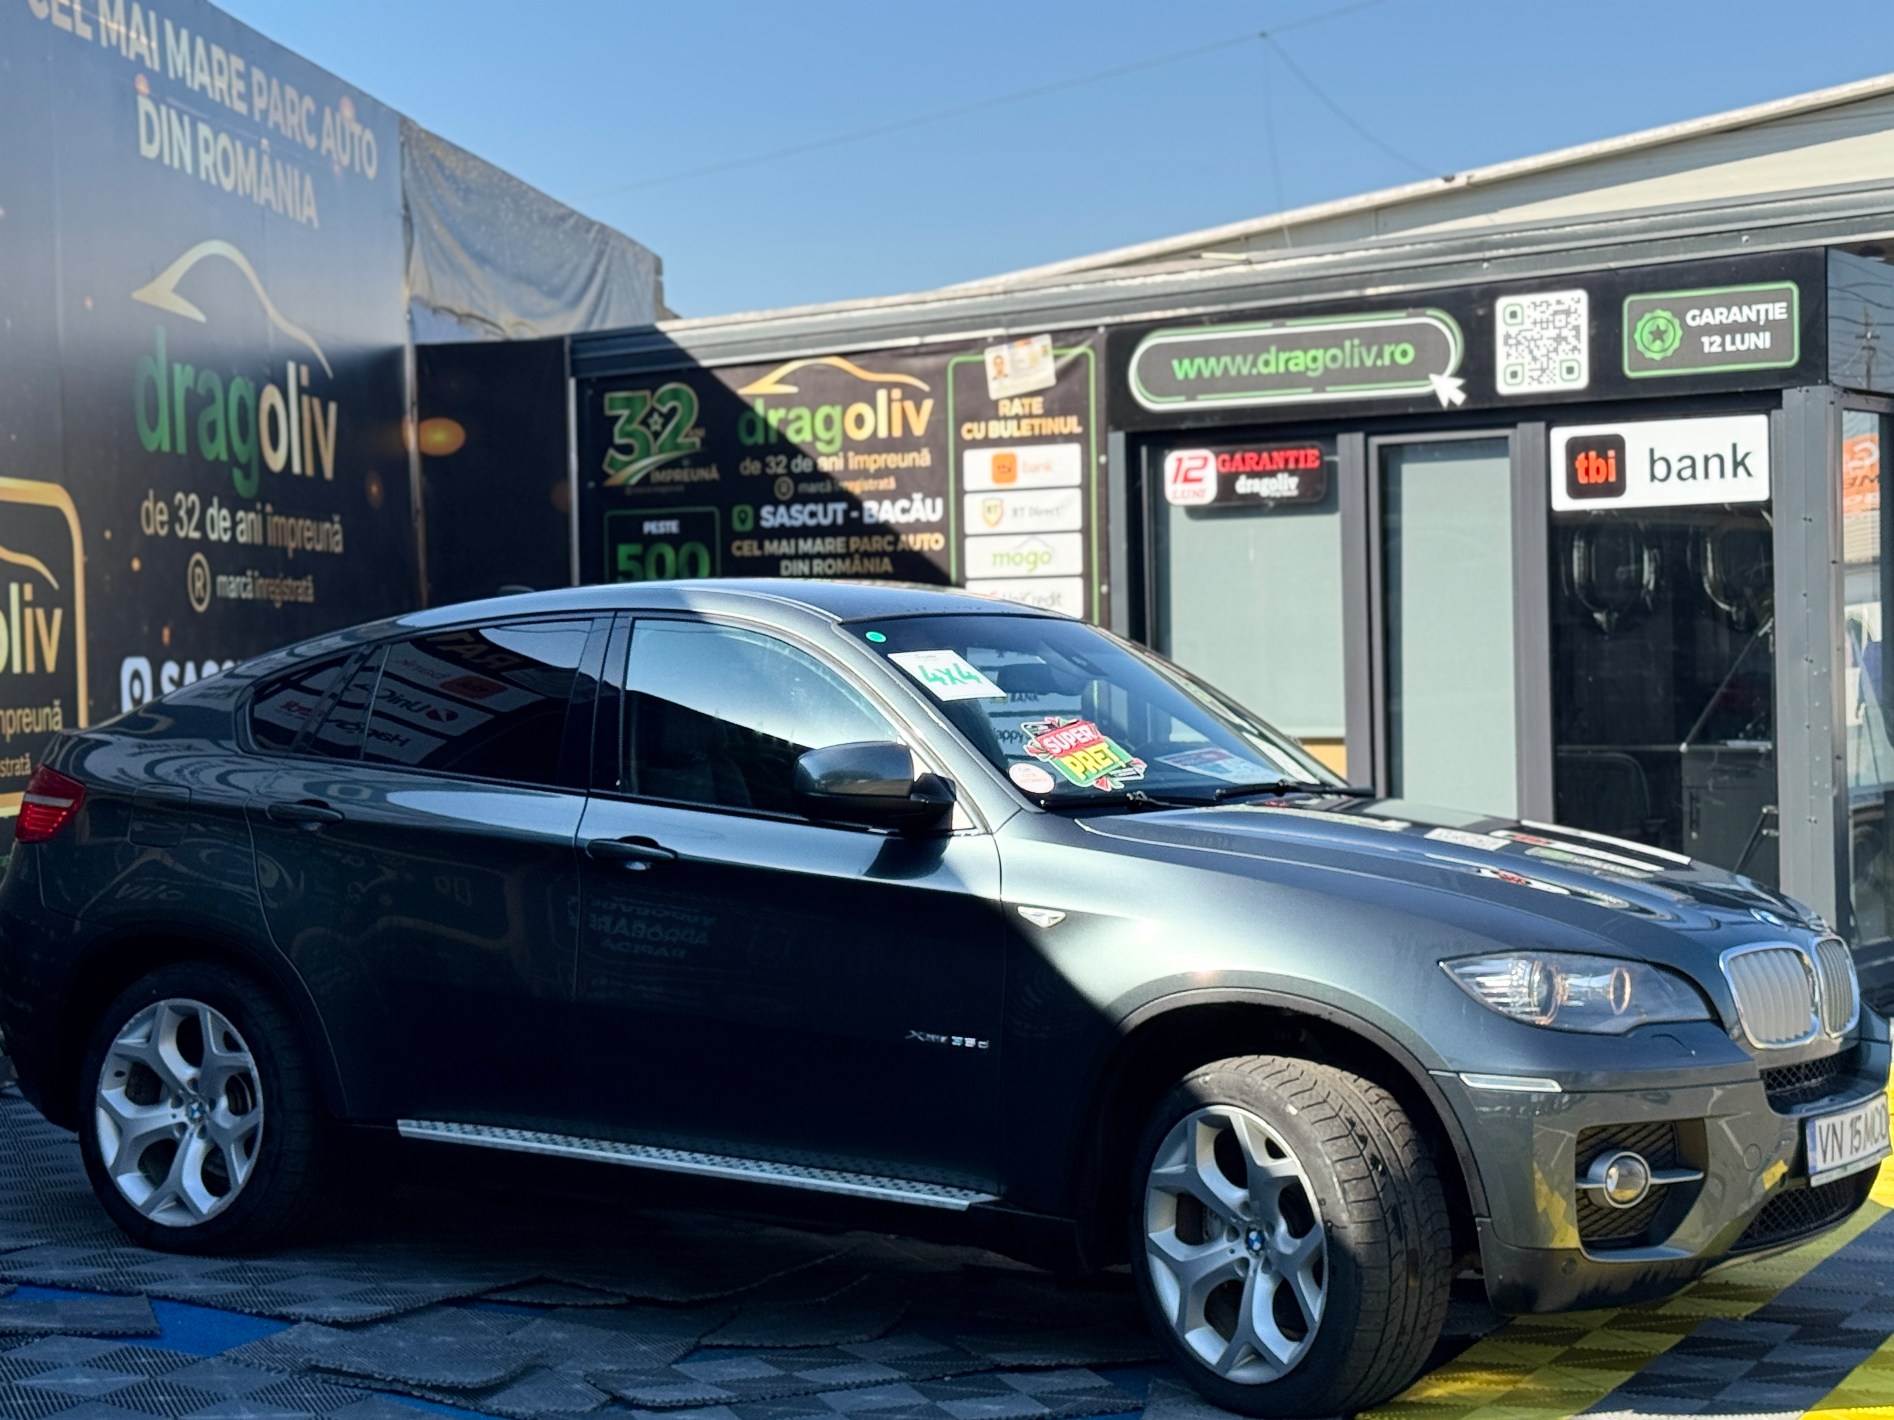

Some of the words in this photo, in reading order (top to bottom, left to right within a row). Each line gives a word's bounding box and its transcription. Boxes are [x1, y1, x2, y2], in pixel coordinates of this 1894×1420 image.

[98, 0, 160, 72] MAI
[164, 18, 248, 115] MARE
[251, 65, 317, 150] PARC
[321, 106, 378, 180] AUTO
[137, 93, 193, 175] DIN
[197, 121, 319, 229] ROMÂNIA
[1685, 302, 1788, 327] GARANȚIE
[1701, 335, 1722, 354] 12
[1725, 331, 1771, 352] LUNI
[1171, 338, 1416, 380] www.dragoliv.ro
[134, 325, 337, 498] dragoliv
[737, 389, 934, 453] dragoliv
[998, 396, 1044, 417] RATE
[602, 382, 699, 476] 32
[961, 421, 986, 440] CU
[987, 416, 1083, 438] BULETINUL
[739, 457, 762, 476] de
[765, 455, 788, 475] 32
[791, 455, 813, 473] de
[817, 454, 844, 472] ani
[1173, 456, 1208, 484] 12
[1575, 450, 1616, 484] tbi
[1649, 443, 1754, 483] bank
[1173, 489, 1206, 500] LUNI
[1235, 472, 1299, 497] dragoliv
[140, 489, 169, 536] de
[174, 491, 201, 539] 32
[206, 496, 232, 542] de
[236, 502, 263, 545] ani
[760, 502, 848, 528] SASCUT
[862, 492, 943, 524] BACĂU
[642, 520, 680, 535] PESTE
[731, 540, 762, 557] CEL
[764, 538, 795, 556] MAI
[802, 536, 846, 554] MARE
[850, 535, 895, 553] PARC
[900, 532, 945, 551] AUTO
[617, 542, 711, 582] 500
[780, 559, 809, 576] DIN
[812, 555, 893, 575] ROMÂNIA
[992, 551, 1053, 575] mogo
[1042, 724, 1099, 754] SUPER
[1819, 1121, 1843, 1164] VN
[1850, 1114, 1862, 1155] 15
